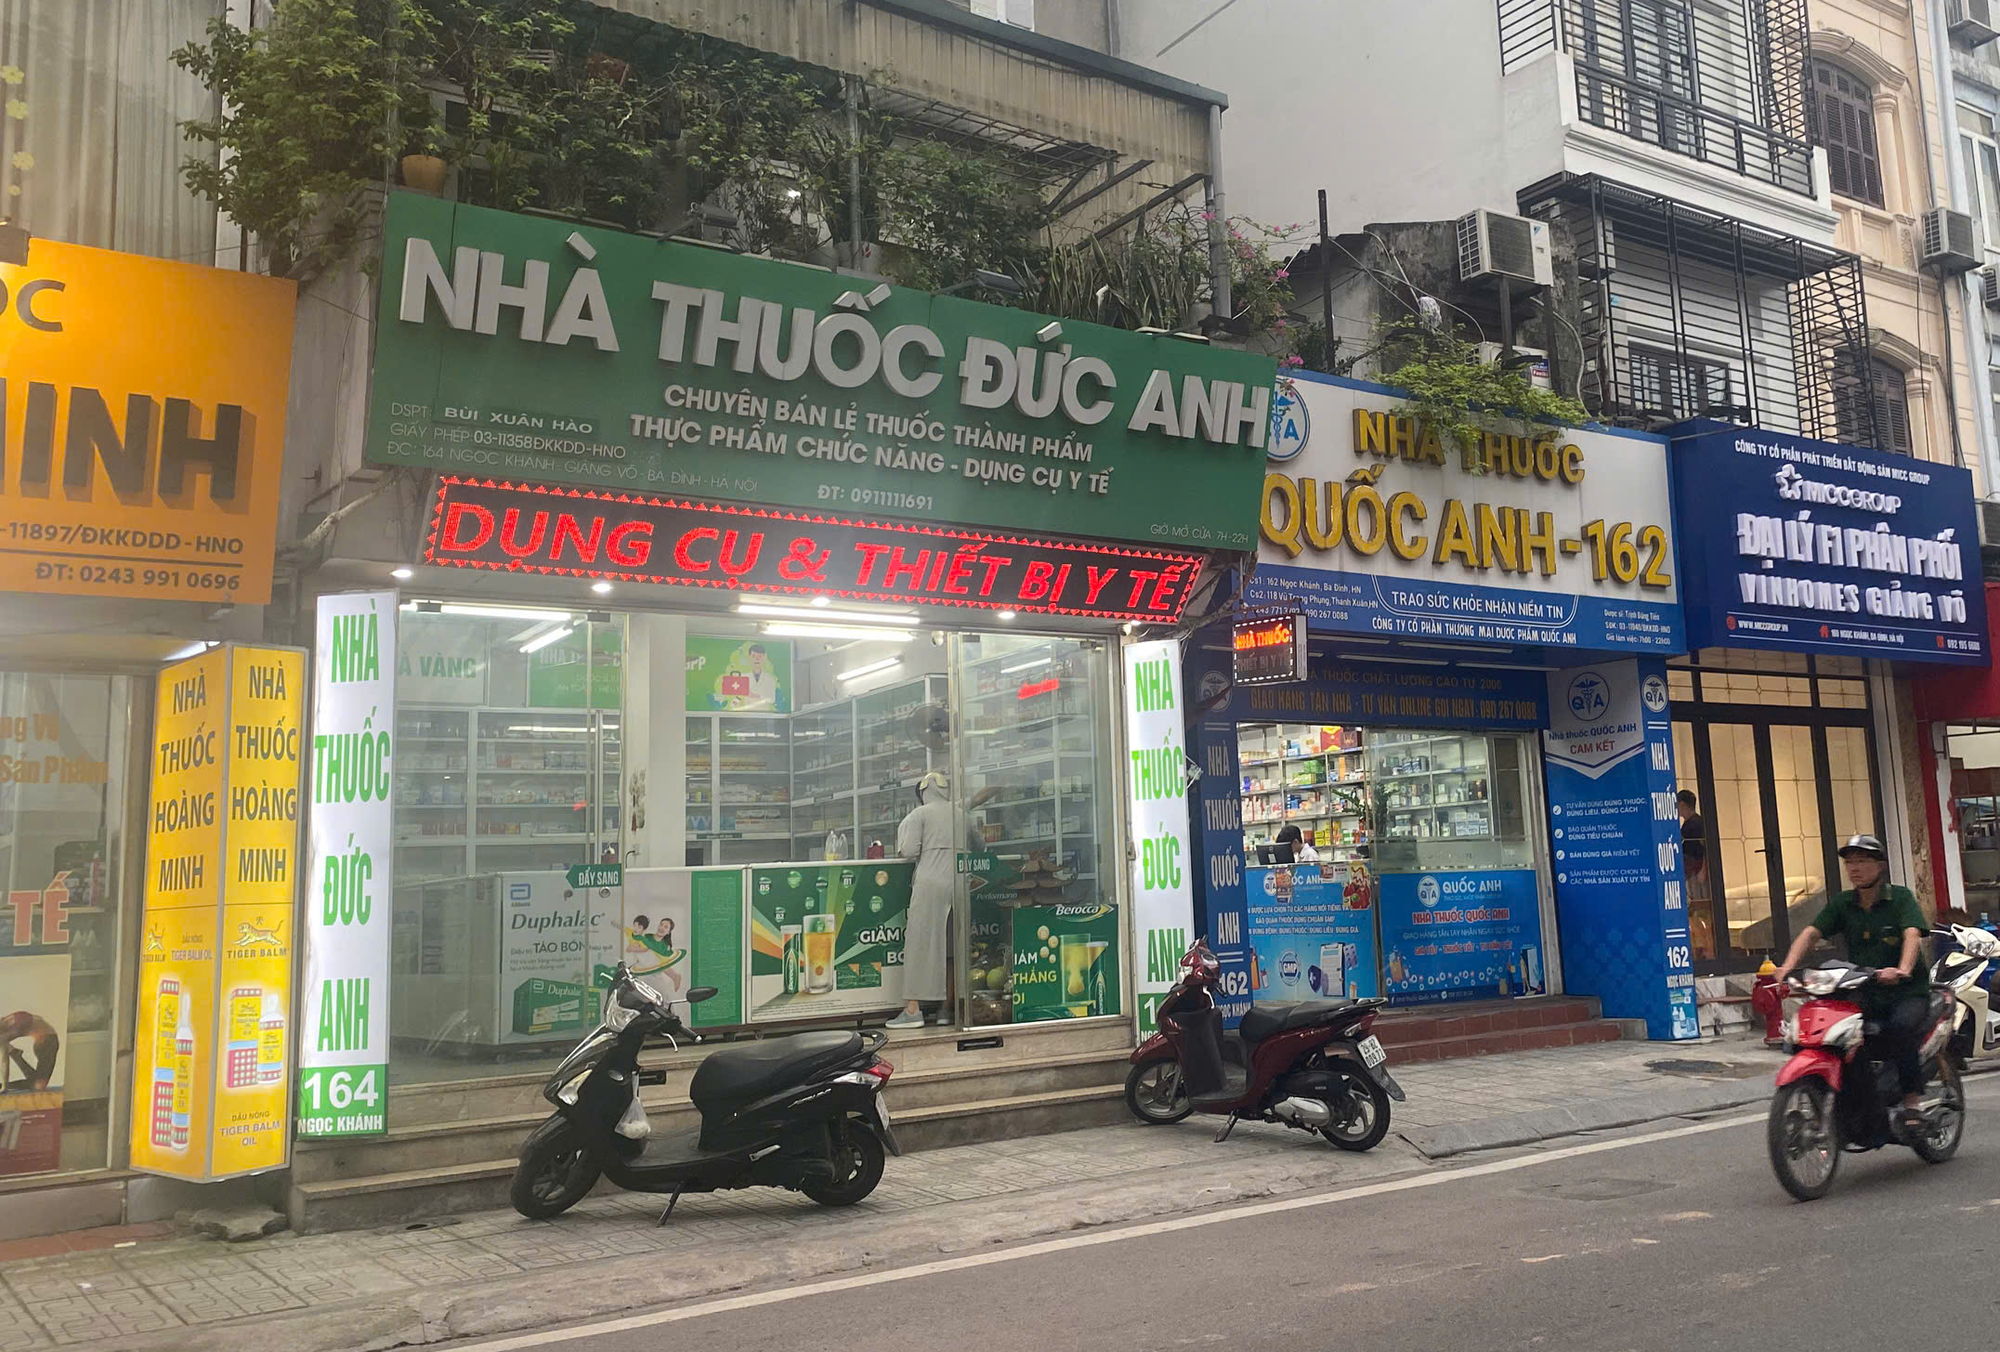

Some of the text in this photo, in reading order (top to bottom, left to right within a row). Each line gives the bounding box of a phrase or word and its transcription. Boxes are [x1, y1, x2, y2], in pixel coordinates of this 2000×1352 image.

[400, 231, 1270, 448] NHÀ THUỐC ĐỨC ANH
[391, 402, 593, 434] DSPT: BÙI XUÂN HÀO
[665, 384, 1093, 462] CHUYÊN BÁN LẺ THUỐC THÀNH PHẨM
[0, 378, 246, 502] INH
[630, 414, 1114, 494] THỰC PHẨM CHỨC NĂNG DỤNG CỤ Y TẾ
[387, 441, 416, 455] ĐC:
[423, 444, 443, 459] 164
[647, 470, 664, 482] BA
[711, 474, 728, 488] HÀ
[1735, 439, 1756, 455] CÔNG
[1757, 444, 1767, 457] TY
[1769, 443, 1779, 459] CỔ
[1802, 451, 1820, 466] PHÁT
[1857, 460, 1876, 477] ĐỘNG
[1877, 463, 1891, 478] SẢN
[1892, 469, 1908, 481] MICC
[1909, 471, 1930, 485] GROUP
[817, 484, 933, 510] ĐT: 0911111691
[1260, 464, 1428, 560] QUỐC
[439, 502, 1190, 612] DỤNG CỤ & THIẾT BỊ Y TẾ
[1737, 510, 1963, 580] ĐẠI LÝ F1 PHÂN PHỐI
[35, 562, 240, 590] ĐT: 0243 991 0696
[1391, 591, 1563, 619] TRAO SỨC KHỎE NHẬN NIỀM TIN
[1739, 573, 1967, 624] VINHOMES GIẢNG VÕ
[331, 598, 380, 684] NHÀ
[1235, 623, 1290, 650] NHÀ THUỐC
[1372, 616, 1393, 631] CÔNG
[1396, 619, 1408, 632] TY
[1541, 627, 1560, 644] QUỐC
[1562, 632, 1577, 644] ANH
[172, 667, 206, 715] NHÀ
[249, 660, 286, 701] NHÀ
[1135, 649, 1174, 713] NHÀ
[160, 721, 215, 776] THUỐC
[236, 717, 297, 761] THUỐC
[1549, 723, 1637, 740] Nhà thuốc QUỐC ANH
[1570, 738, 1616, 755] CAM KẾT
[314, 705, 390, 804] THUỐC
[1131, 727, 1185, 801] THUỐC
[1207, 740, 1231, 777] NHÀ
[1651, 737, 1670, 771] NHÀ
[154, 792, 215, 834] HOÀNG
[232, 784, 297, 822] HOÀNG
[1204, 790, 1240, 832] THUỐC
[1650, 784, 1678, 821] THUỐC
[159, 854, 204, 892] MINH
[238, 848, 286, 883] MINH
[1143, 822, 1181, 891] ĐỨC
[1210, 845, 1240, 892] QUỐC
[322, 833, 373, 927] ĐỨC
[1442, 876, 1502, 894] QUỐC ANH
[1664, 881, 1681, 910] ANH
[1055, 903, 1100, 917] Berocca
[1218, 912, 1241, 945] ANH
[1412, 905, 1510, 925] NHÀ THUỐC QUỐC ANH
[227, 948, 287, 959] TIGER BALM
[859, 925, 900, 944] GIẢM
[1147, 928, 1186, 983] ANH
[1283, 961, 1297, 974] GMP
[1667, 945, 1690, 968] 162
[1219, 971, 1249, 996] 162
[317, 977, 370, 1052] ANH
[304, 1070, 378, 1110] 164
[219, 1119, 281, 1137] TIGER BALM
[241, 1138, 257, 1147] OIL
[297, 1113, 382, 1136] NGỌC KHÁNH
